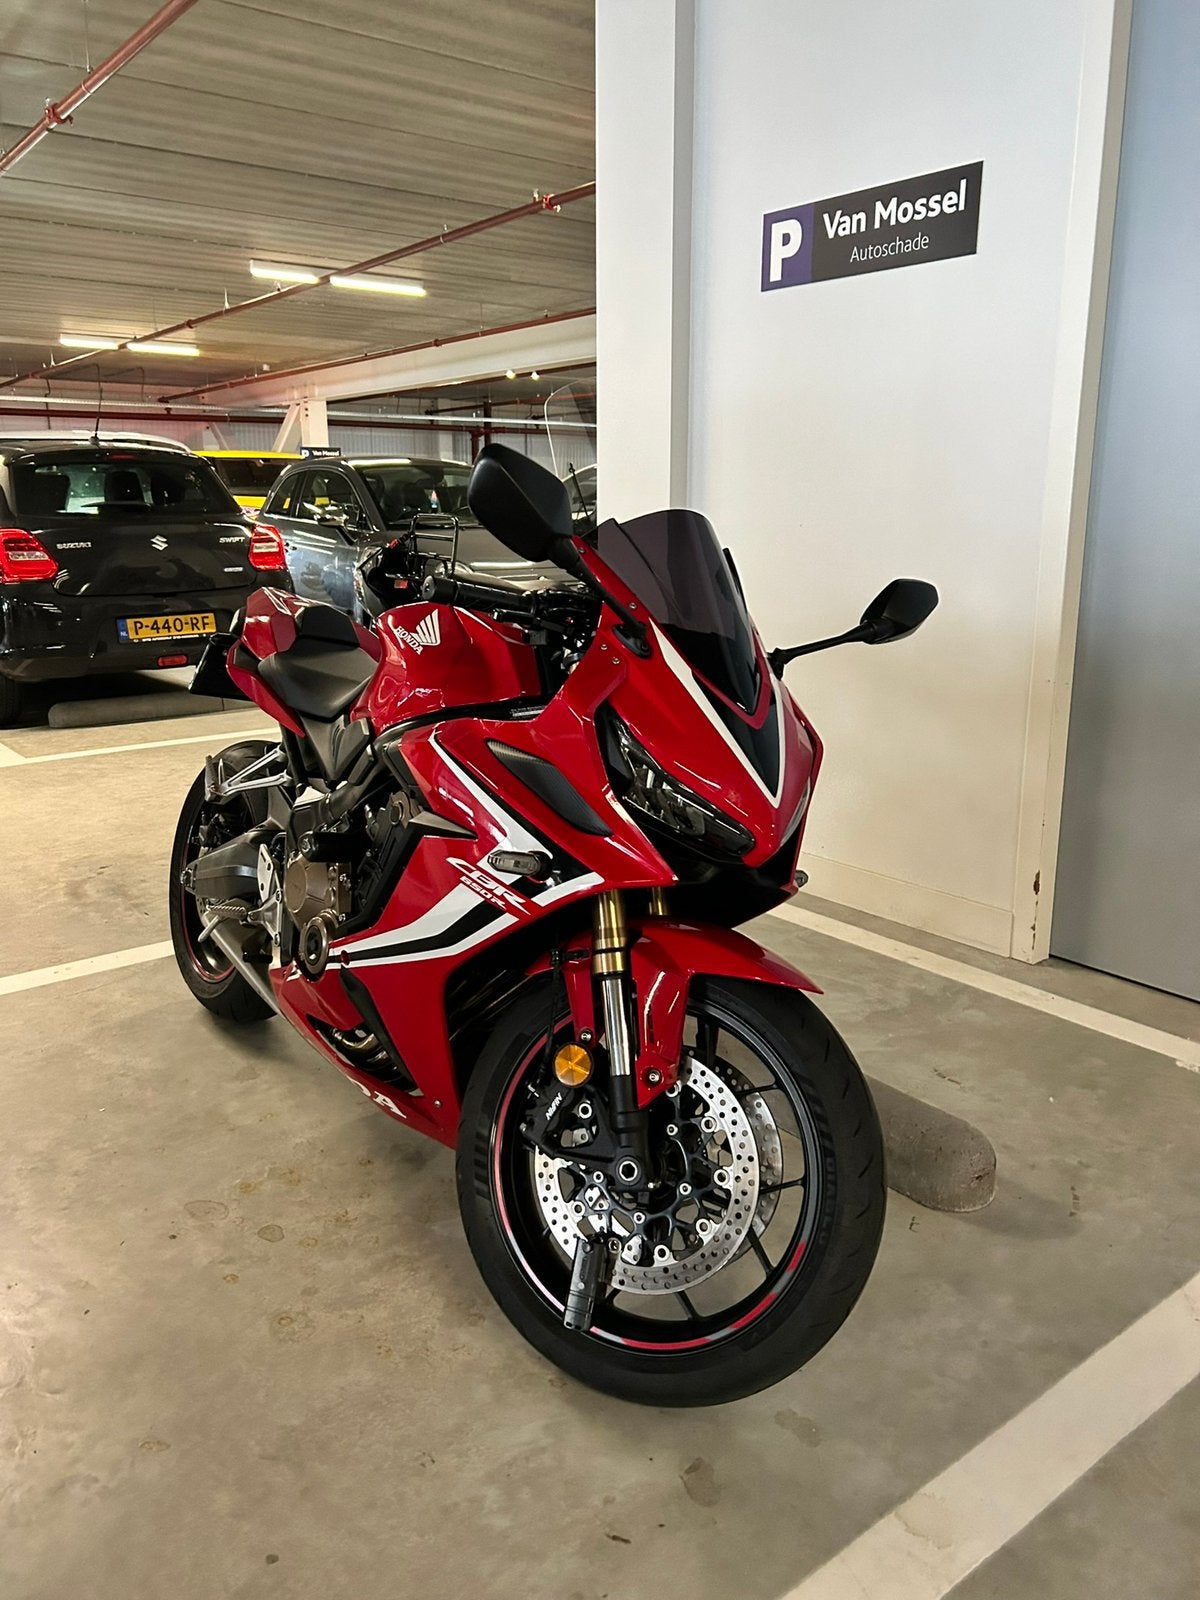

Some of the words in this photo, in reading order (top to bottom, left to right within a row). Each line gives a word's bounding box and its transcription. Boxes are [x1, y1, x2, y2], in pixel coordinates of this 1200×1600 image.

[823, 209, 866, 240] Van
[873, 178, 967, 230] Mossel
[769, 218, 803, 283] P
[849, 232, 930, 263] Autoschade
[56, 541, 92, 549] SUZUKI
[133, 616, 210, 636] P-440-RF
[395, 625, 424, 655] HONDA
